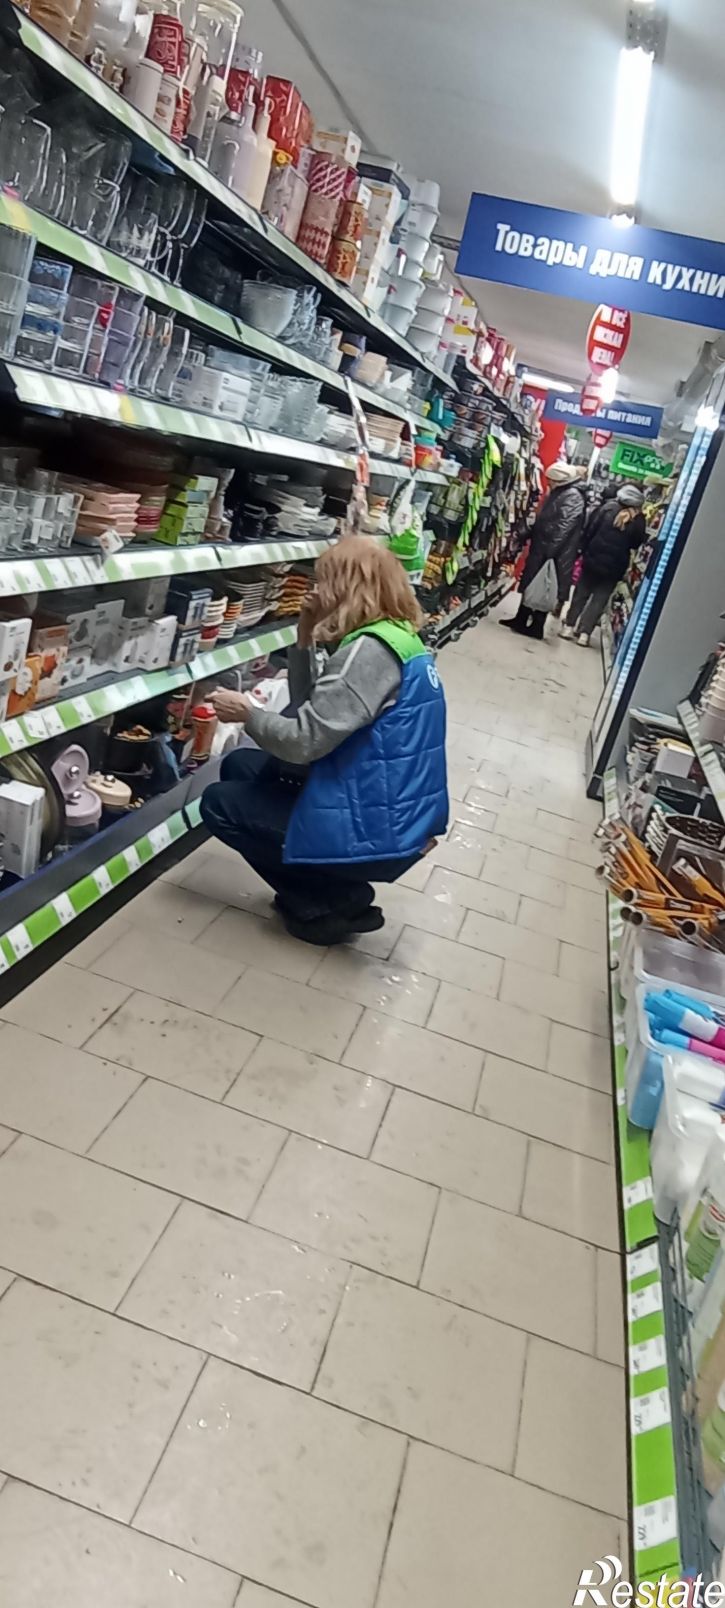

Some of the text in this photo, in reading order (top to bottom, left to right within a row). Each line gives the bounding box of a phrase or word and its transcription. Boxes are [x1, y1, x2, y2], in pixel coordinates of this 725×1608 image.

[495, 223, 725, 299] Товары для кухни
[554, 398, 606, 418] Проды
[621, 448, 645, 466] FIX
